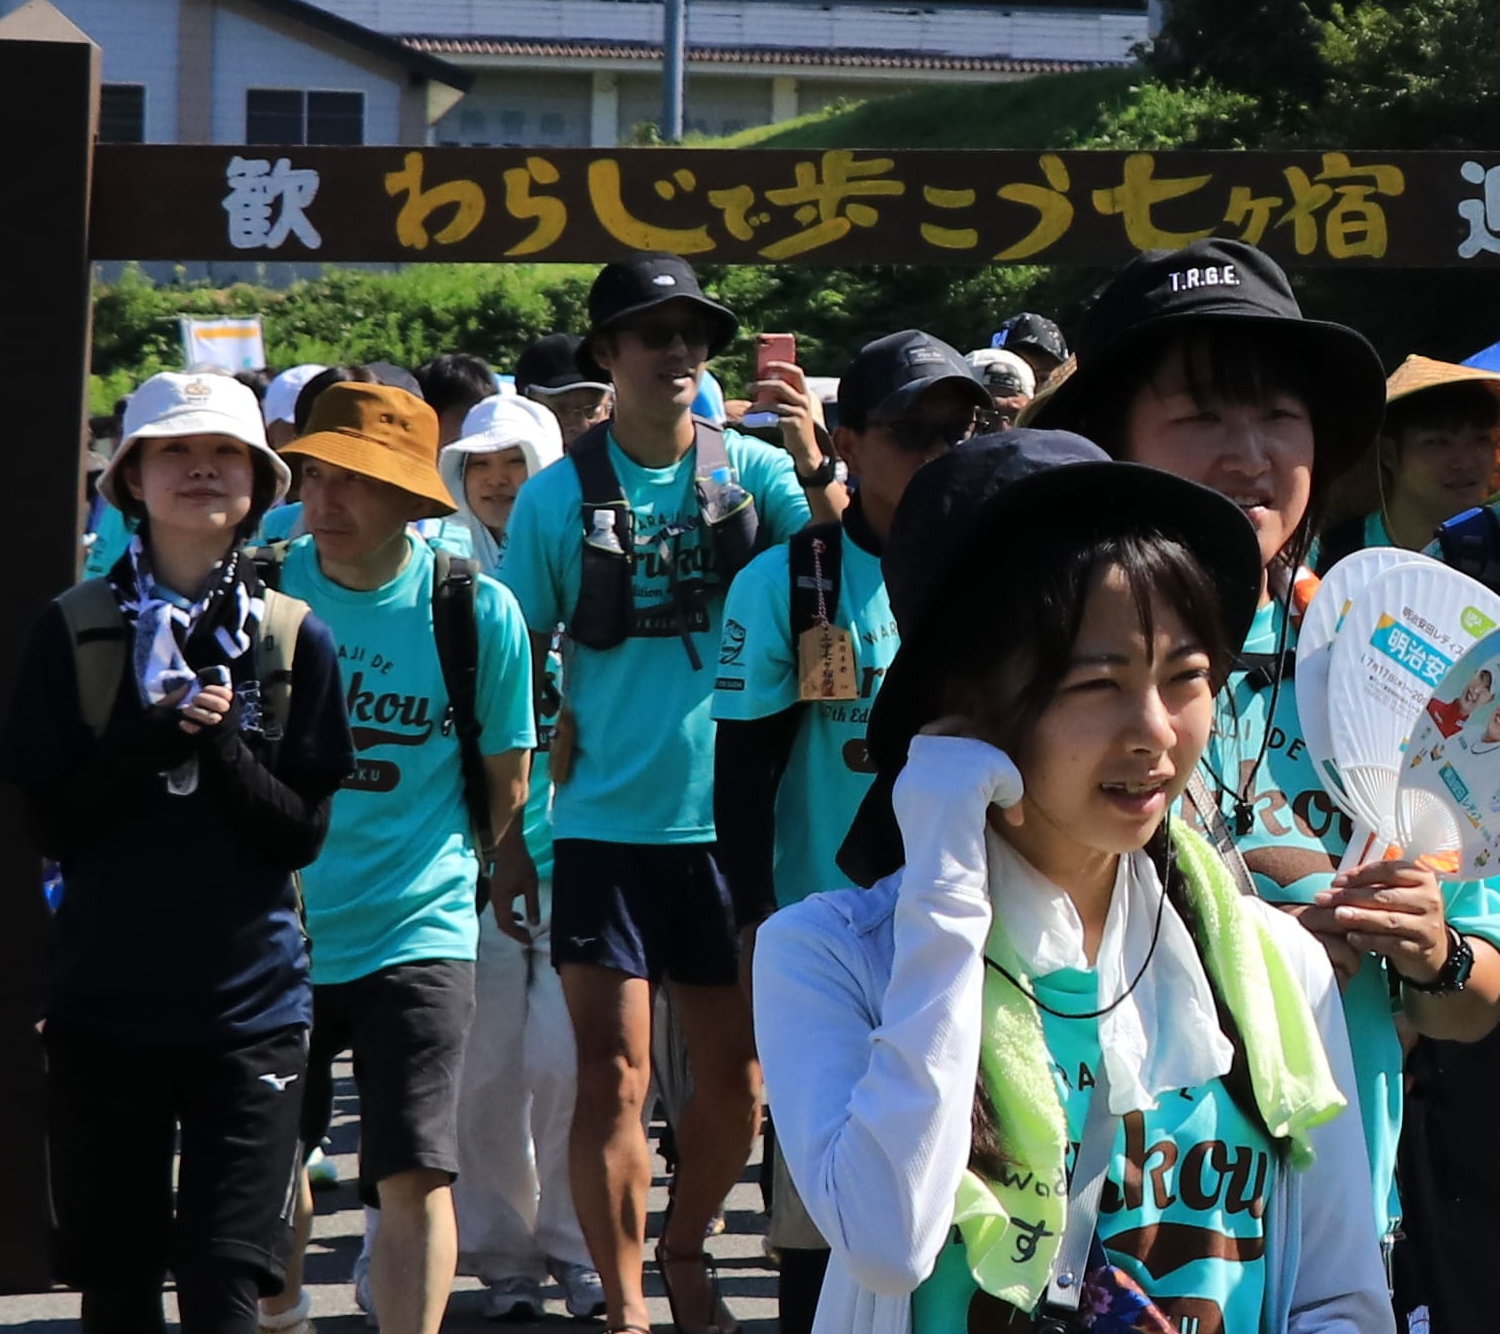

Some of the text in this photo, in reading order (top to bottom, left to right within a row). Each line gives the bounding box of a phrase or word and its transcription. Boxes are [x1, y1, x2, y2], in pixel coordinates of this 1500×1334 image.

[222, 155, 324, 253] 歓
[385, 148, 1406, 261] わらじで歩こう七ヶ宿
[1168, 266, 1241, 293] T.R.G.E.
[370, 652, 395, 675] DE
[1387, 627, 1451, 685] 明治安
[1266, 726, 1307, 762] DE
